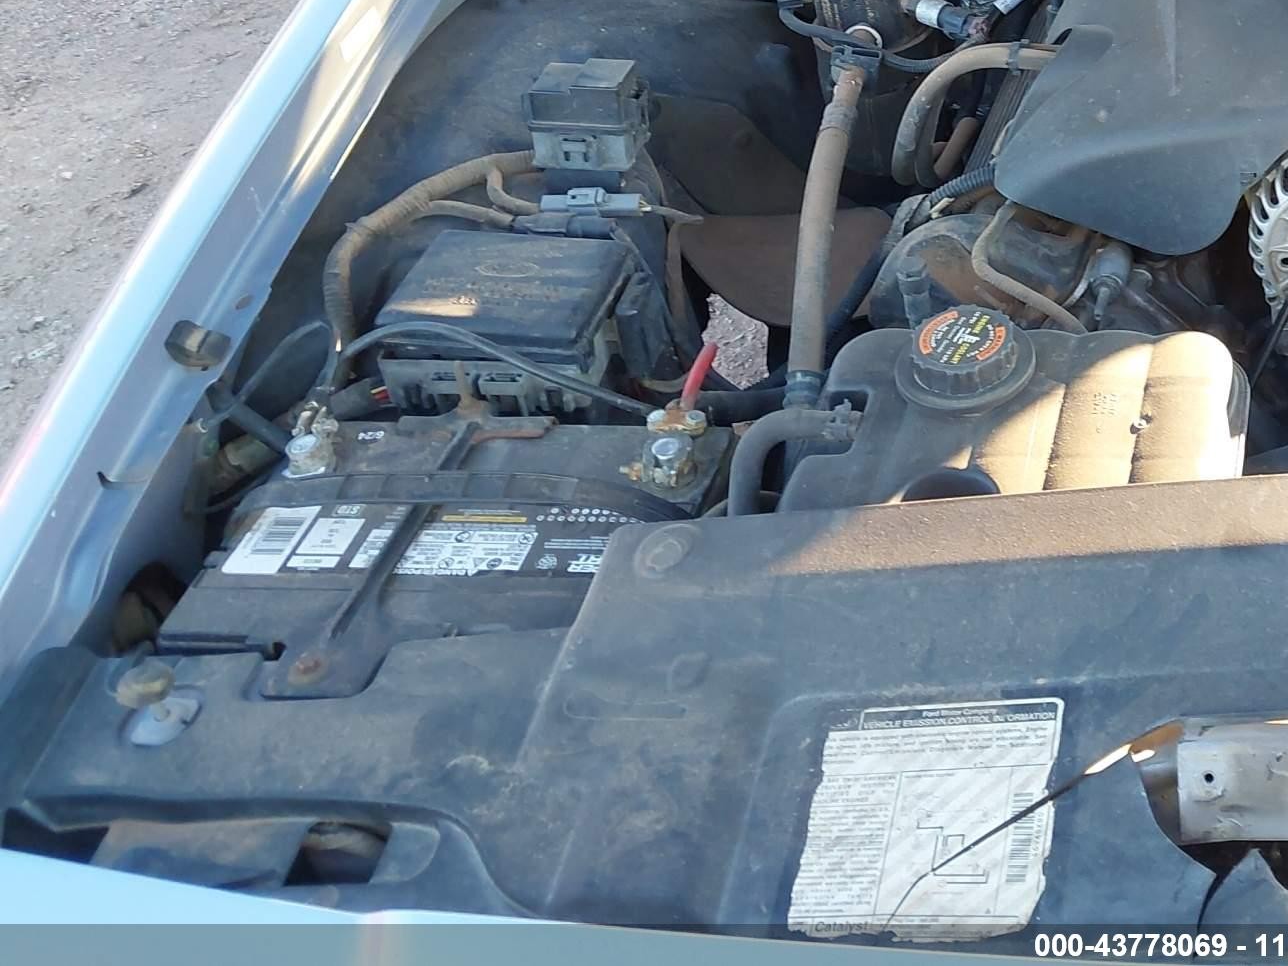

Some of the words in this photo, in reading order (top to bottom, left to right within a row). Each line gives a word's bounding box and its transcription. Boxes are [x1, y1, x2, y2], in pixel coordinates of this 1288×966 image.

[947, 715, 991, 725] CONTROL
[992, 712, 1056, 723] INORMATION
[815, 920, 869, 933] Catalyst
